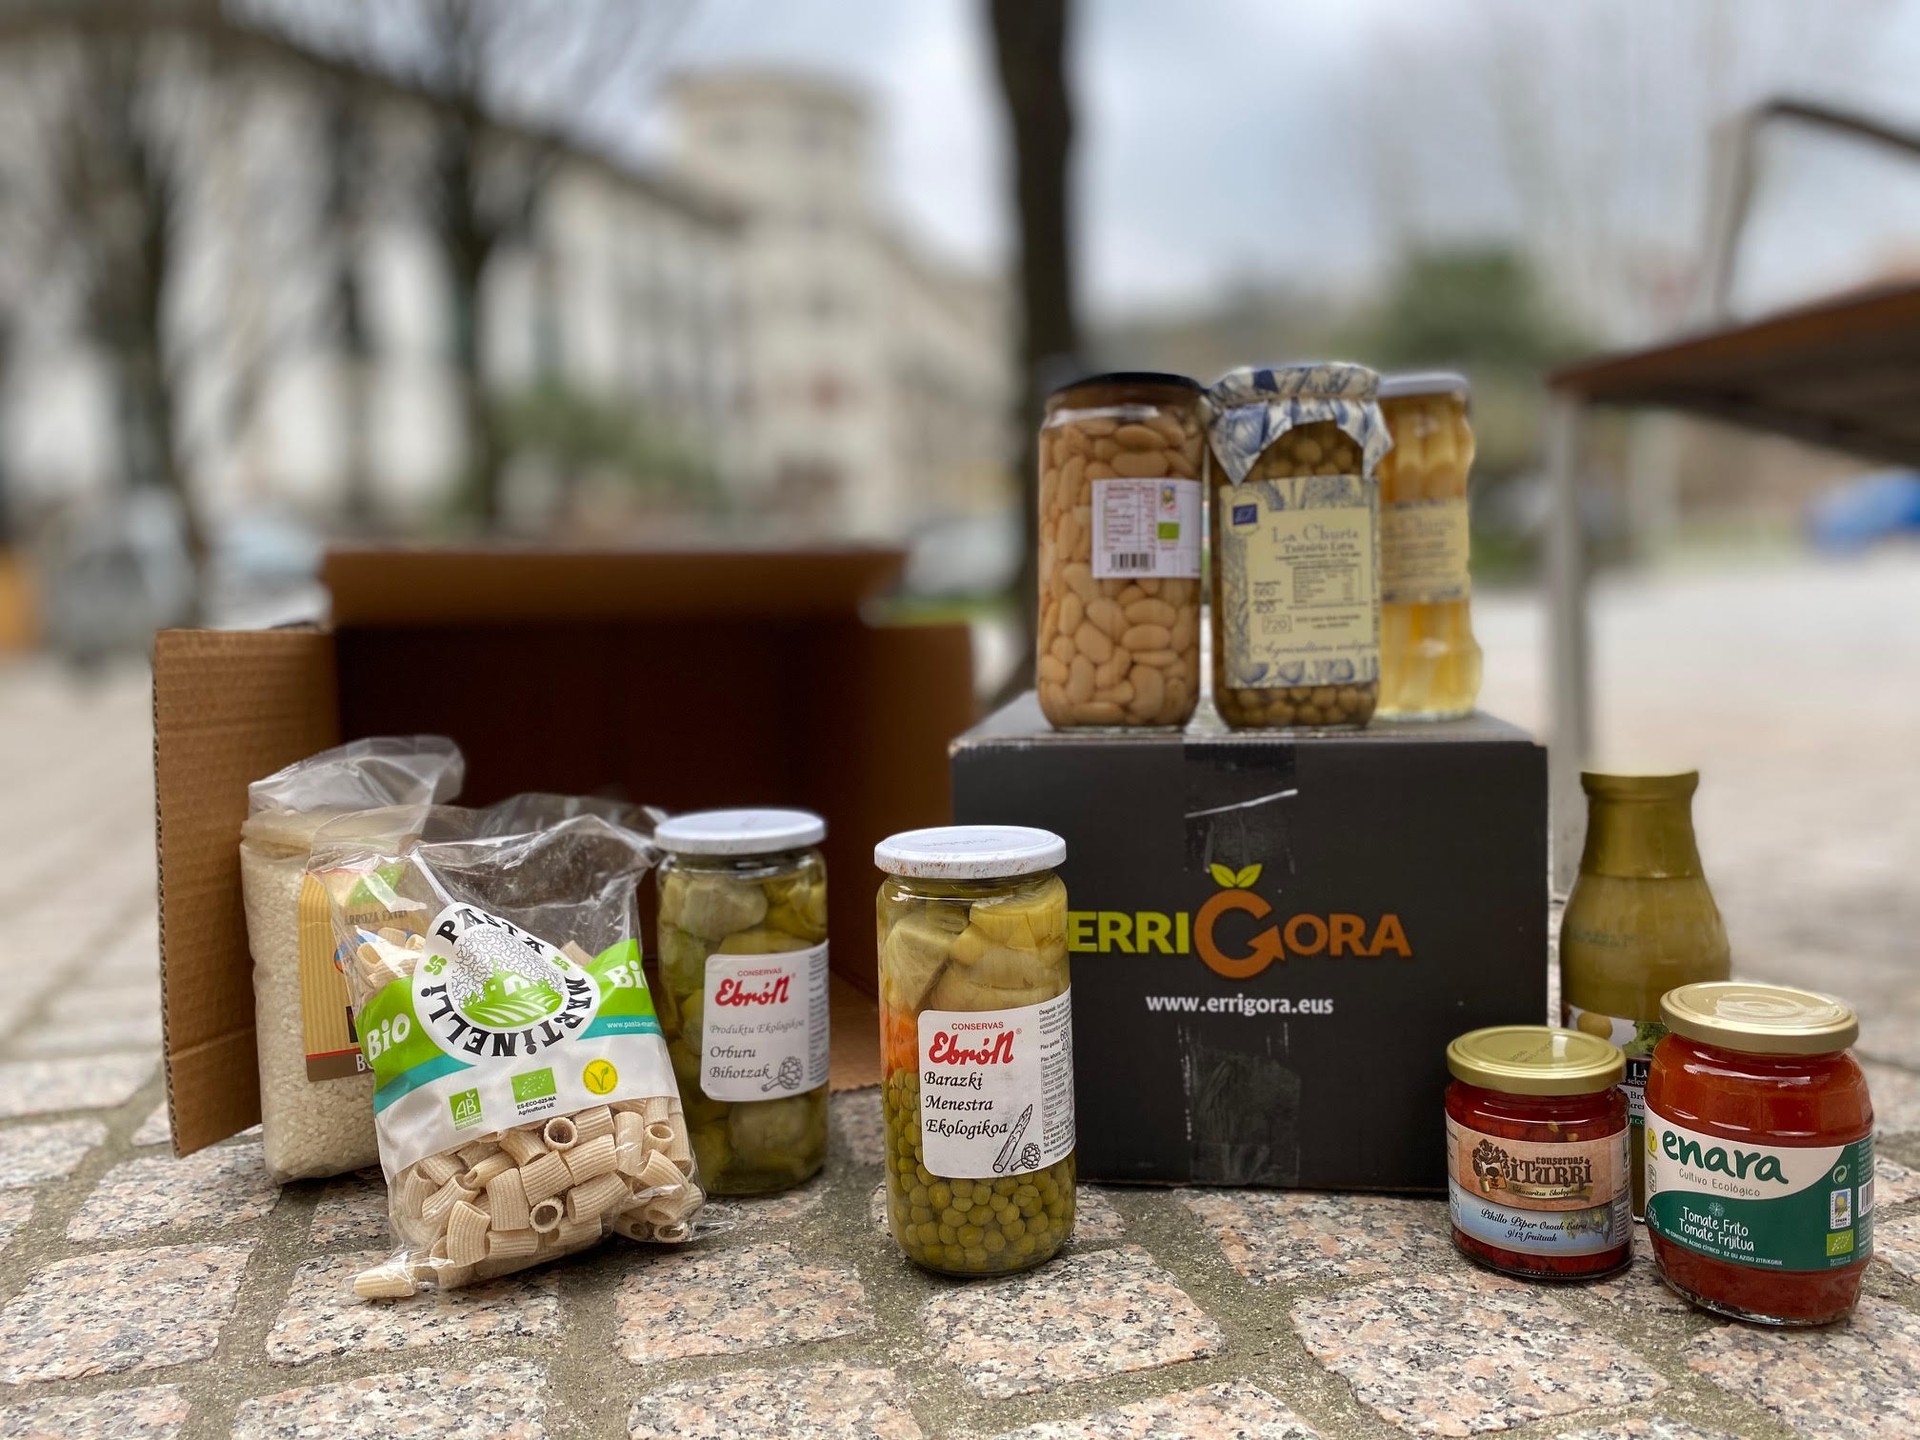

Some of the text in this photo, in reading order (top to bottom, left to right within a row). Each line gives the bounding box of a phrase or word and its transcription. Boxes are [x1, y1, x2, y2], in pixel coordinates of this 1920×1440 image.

[436, 908, 545, 955] PASTA
[1067, 888, 1413, 979] ERRIGORA
[604, 960, 648, 988] Bi
[737, 967, 782, 977] CONSERVAS
[1146, 993, 1334, 1017] www.errigora.eus
[709, 1024, 755, 1036] Produktu
[951, 1021, 1004, 1031] CONSERVAS
[710, 1045, 756, 1059] Orburu
[709, 1063, 773, 1080] Bihotzak
[924, 1071, 983, 1090] Barazki
[455, 1098, 477, 1120] AB
[518, 1106, 547, 1116] Agricultura
[925, 1095, 994, 1111] Menestra
[925, 1118, 1009, 1140] Ekologikoa
[1535, 1156, 1584, 1166] conservas
[1662, 1130, 1789, 1185] enara
[1679, 1168, 1708, 1186] Cultivo
[1712, 1178, 1760, 1197] Ecológico
[1510, 1216, 1538, 1231] Piper
[1683, 1206, 1749, 1237] Tomate Frito
[1522, 1232, 1557, 1243] fruituak
[1679, 1217, 1755, 1252] Tomate Frijitua
[1739, 1254, 1755, 1263] AZIDO
